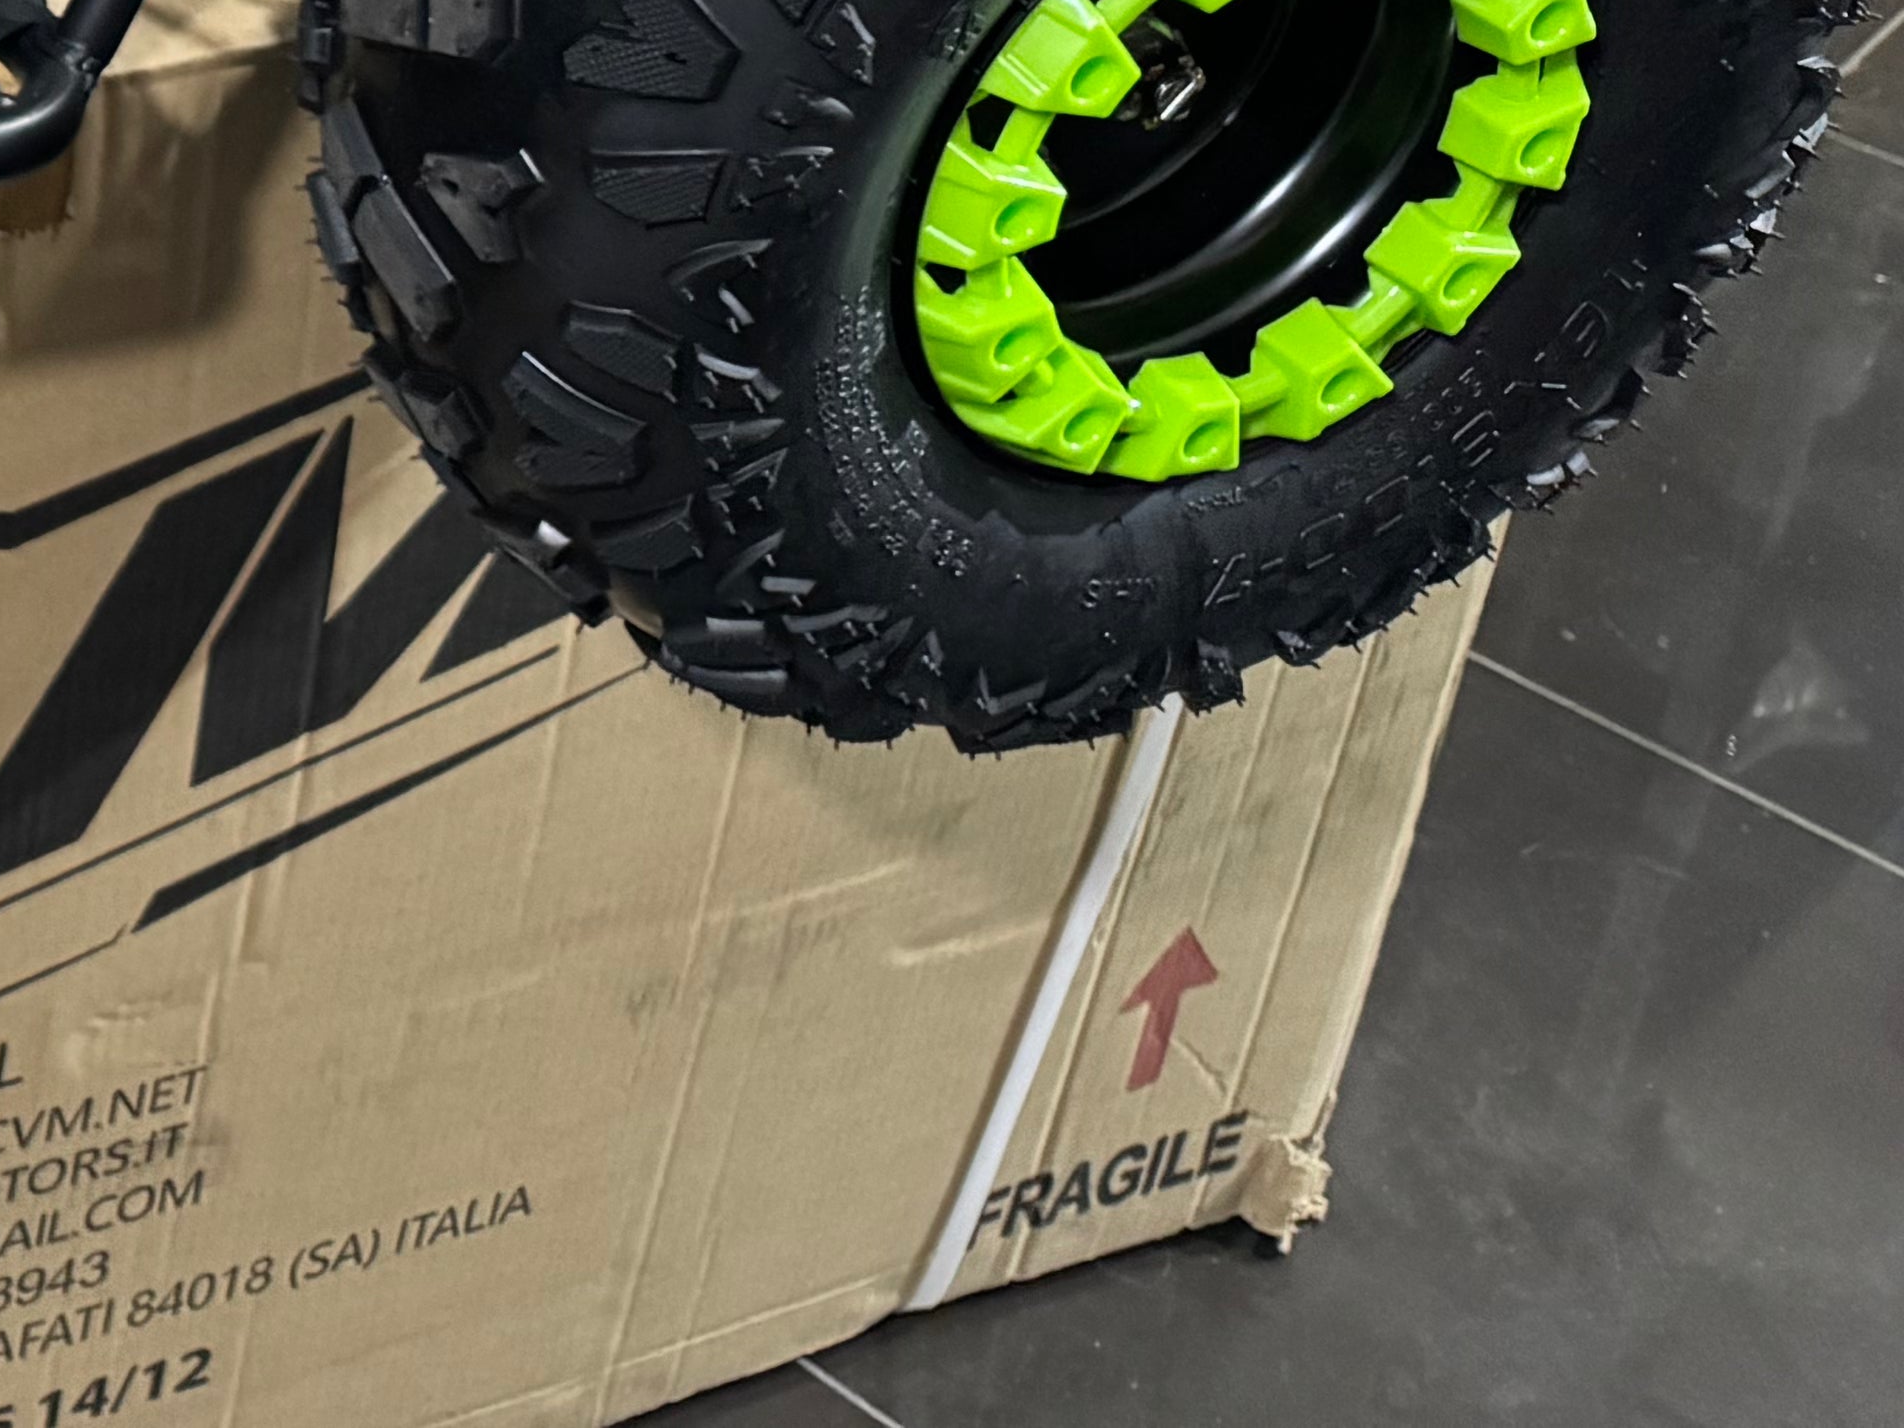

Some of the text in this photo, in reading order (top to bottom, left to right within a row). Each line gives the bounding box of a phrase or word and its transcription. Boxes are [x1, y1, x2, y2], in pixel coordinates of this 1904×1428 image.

[968, 1110, 1252, 1250] FRAGILE
[126, 1255, 273, 1329] 84018
[289, 1227, 381, 1290] (SA)
[395, 1185, 533, 1255] ITALIA
[37, 1347, 213, 1428] 14/12
